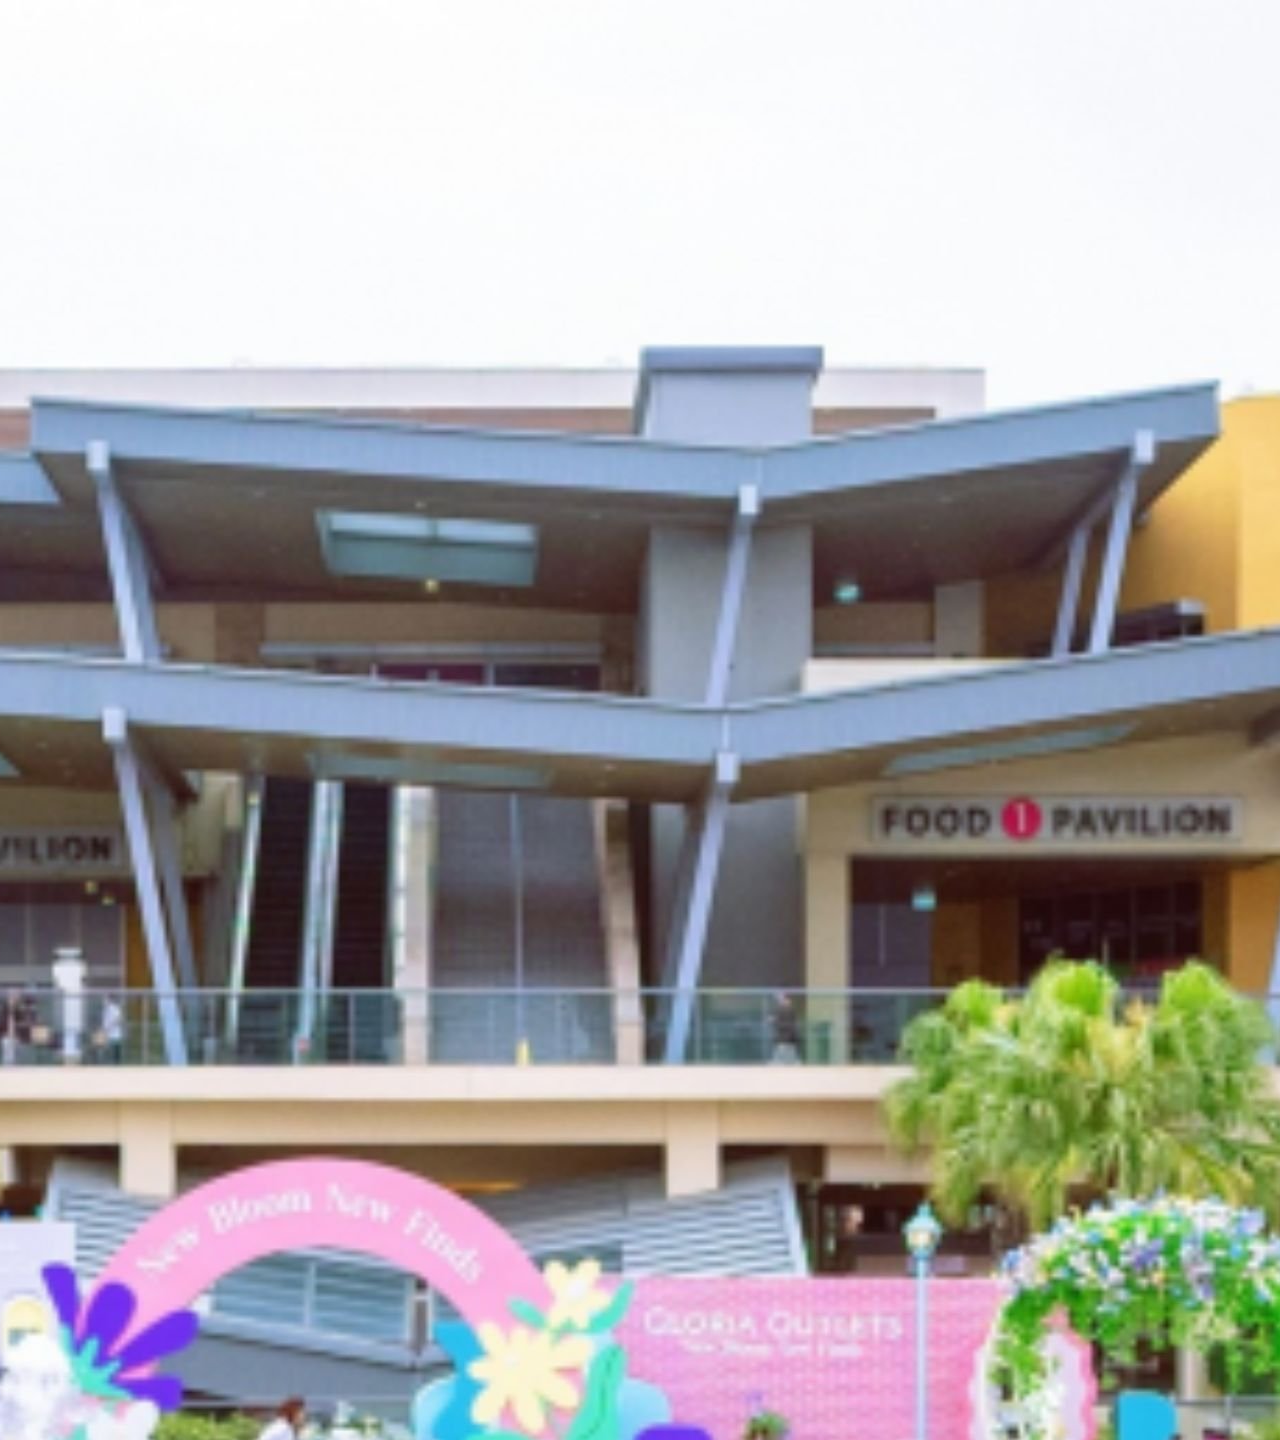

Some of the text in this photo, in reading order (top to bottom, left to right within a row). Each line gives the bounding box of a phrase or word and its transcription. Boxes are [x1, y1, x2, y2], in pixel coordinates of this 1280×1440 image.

[881, 805, 991, 838] FOOD
[1051, 804, 1233, 837] PAVILION
[135, 1182, 483, 1285] New Bloom New Finds
[643, 1306, 904, 1341] GLORIA OUTLETS
